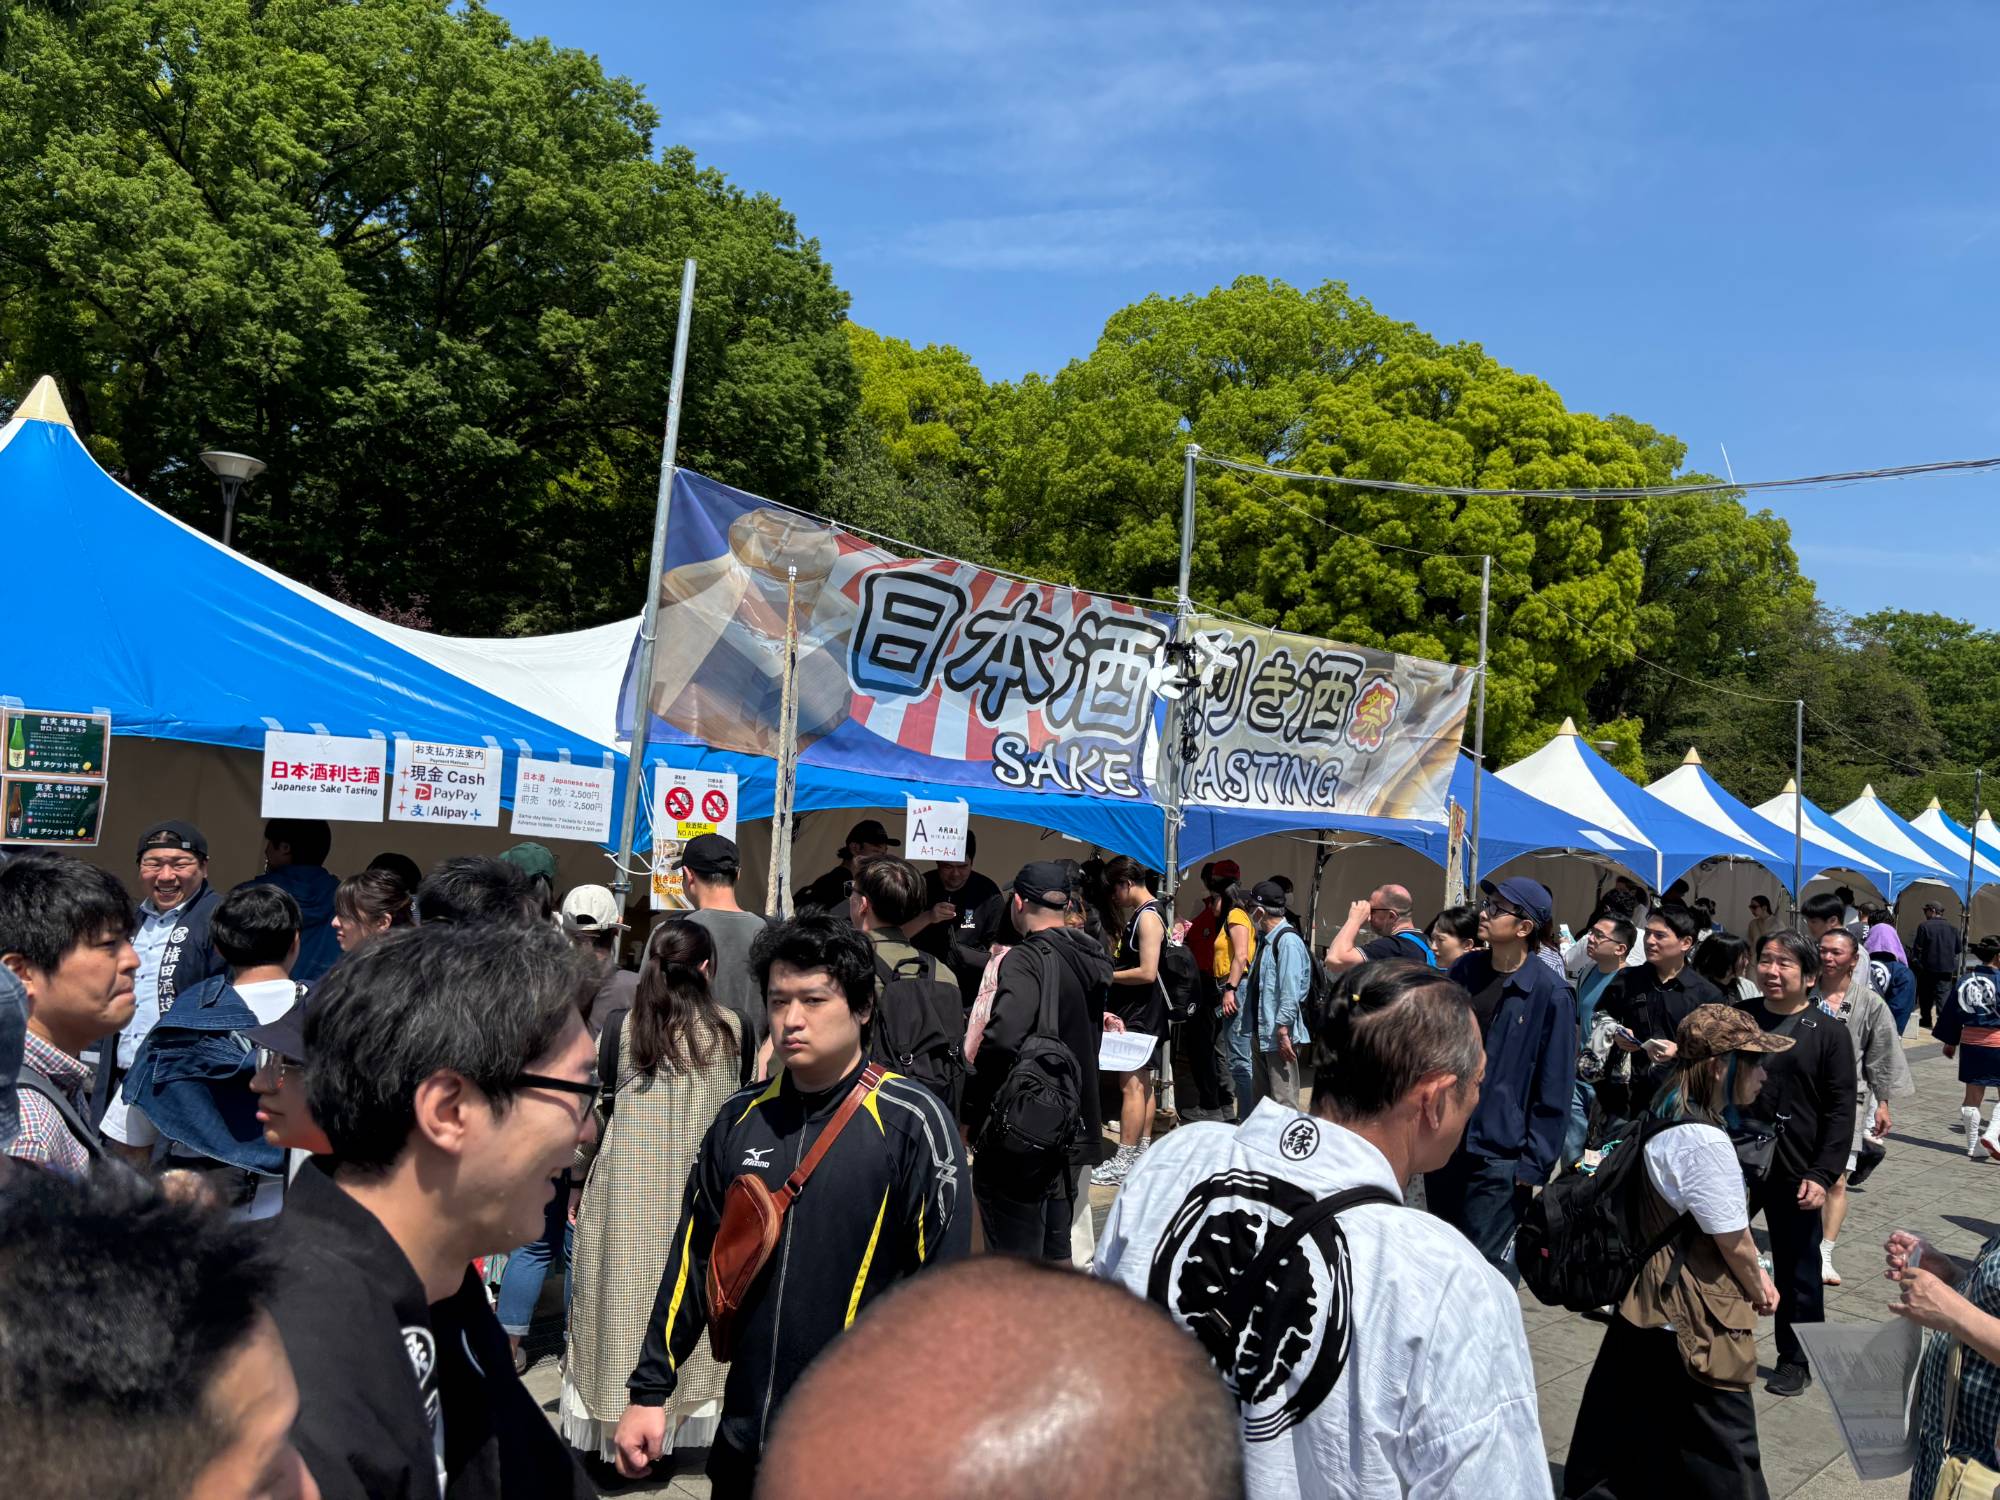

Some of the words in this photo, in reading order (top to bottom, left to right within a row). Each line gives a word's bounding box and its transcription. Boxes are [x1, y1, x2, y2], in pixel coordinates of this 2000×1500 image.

[415, 745, 484, 761] お支払方法案内
[271, 761, 380, 784] 日本酒利き酒
[992, 732, 1144, 796] SAKE
[411, 765, 443, 783] 現金
[447, 771, 485, 786] Cash
[523, 772, 545, 782] 日本酒
[552, 776, 583, 787] Japanese
[271, 782, 317, 792] Japanese
[320, 784, 341, 794] Sake
[345, 786, 378, 796] Tasting
[434, 787, 477, 803] PayPay
[912, 819, 928, 842] A
